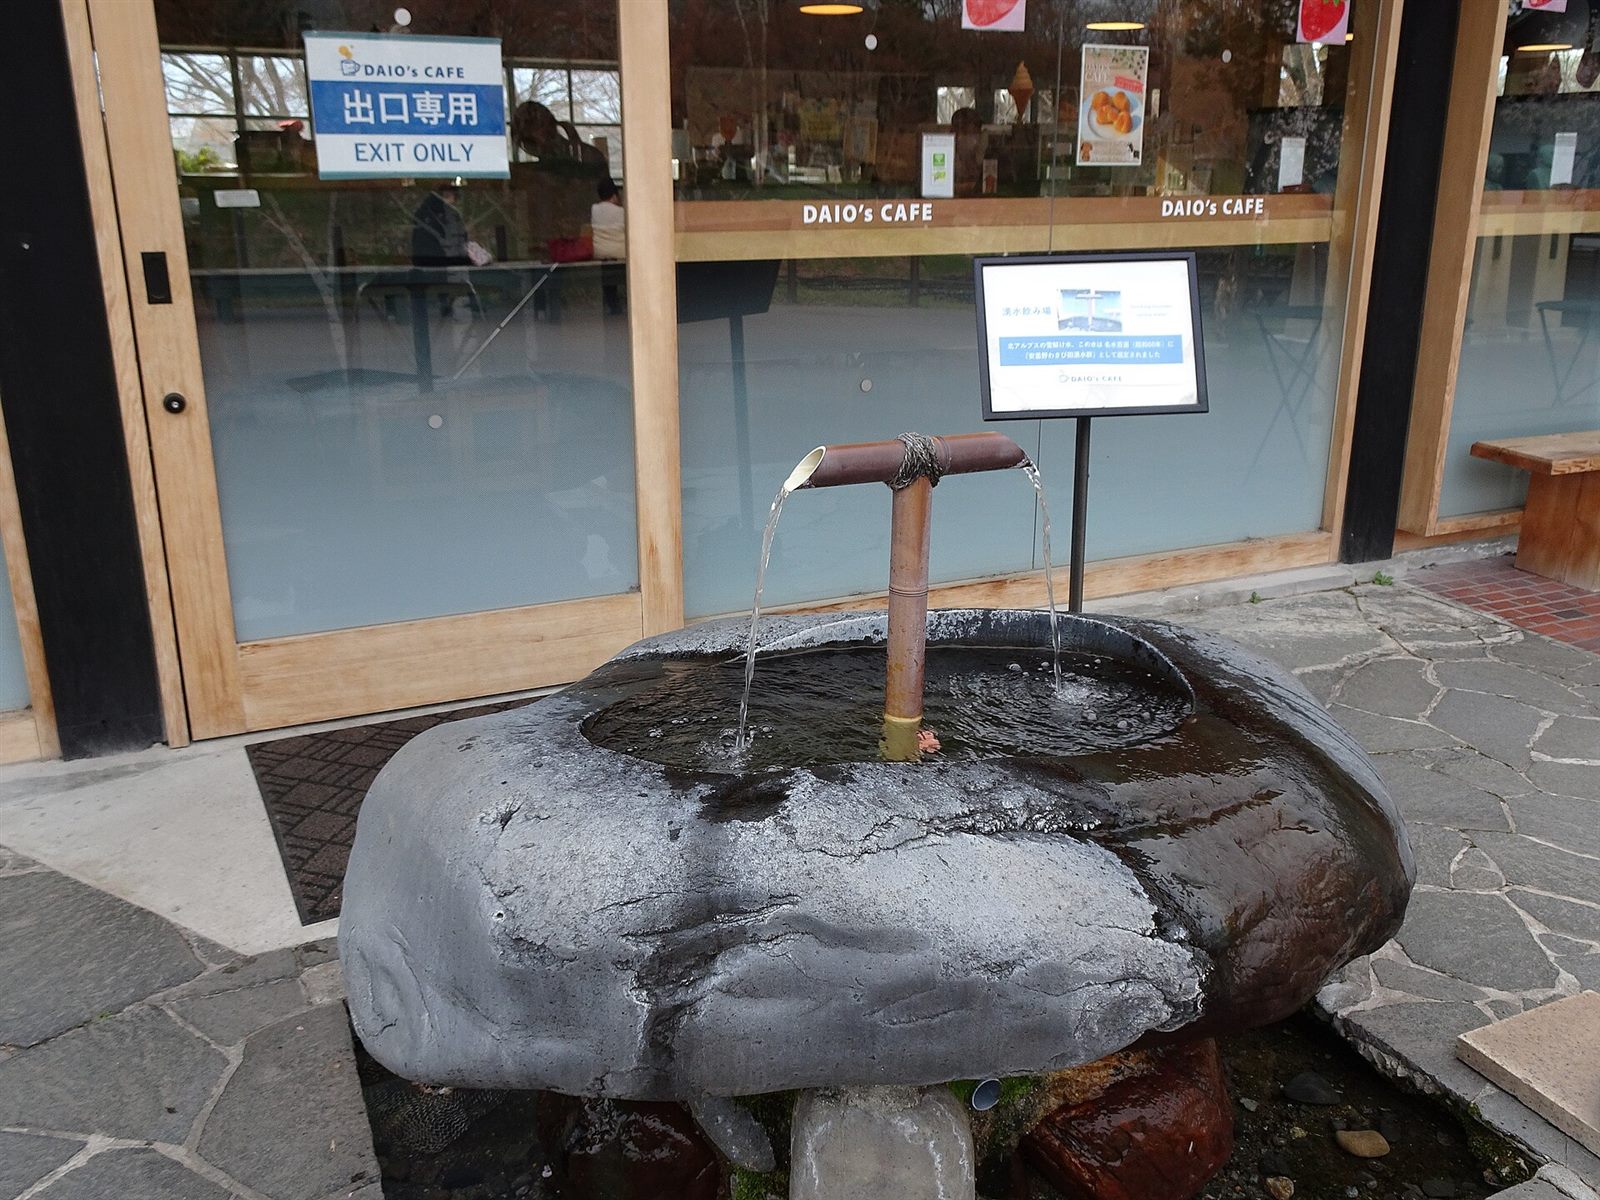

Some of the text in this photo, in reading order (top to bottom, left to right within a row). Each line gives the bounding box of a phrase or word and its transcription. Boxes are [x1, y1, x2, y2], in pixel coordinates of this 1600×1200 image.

[364, 64, 465, 79] DAIO's CAFE
[343, 89, 479, 126] 出口専用
[354, 143, 474, 162] EXIT ONLY
[803, 203, 933, 224] DAIO's CAFE
[1161, 198, 1264, 217] DAIO's CAFE
